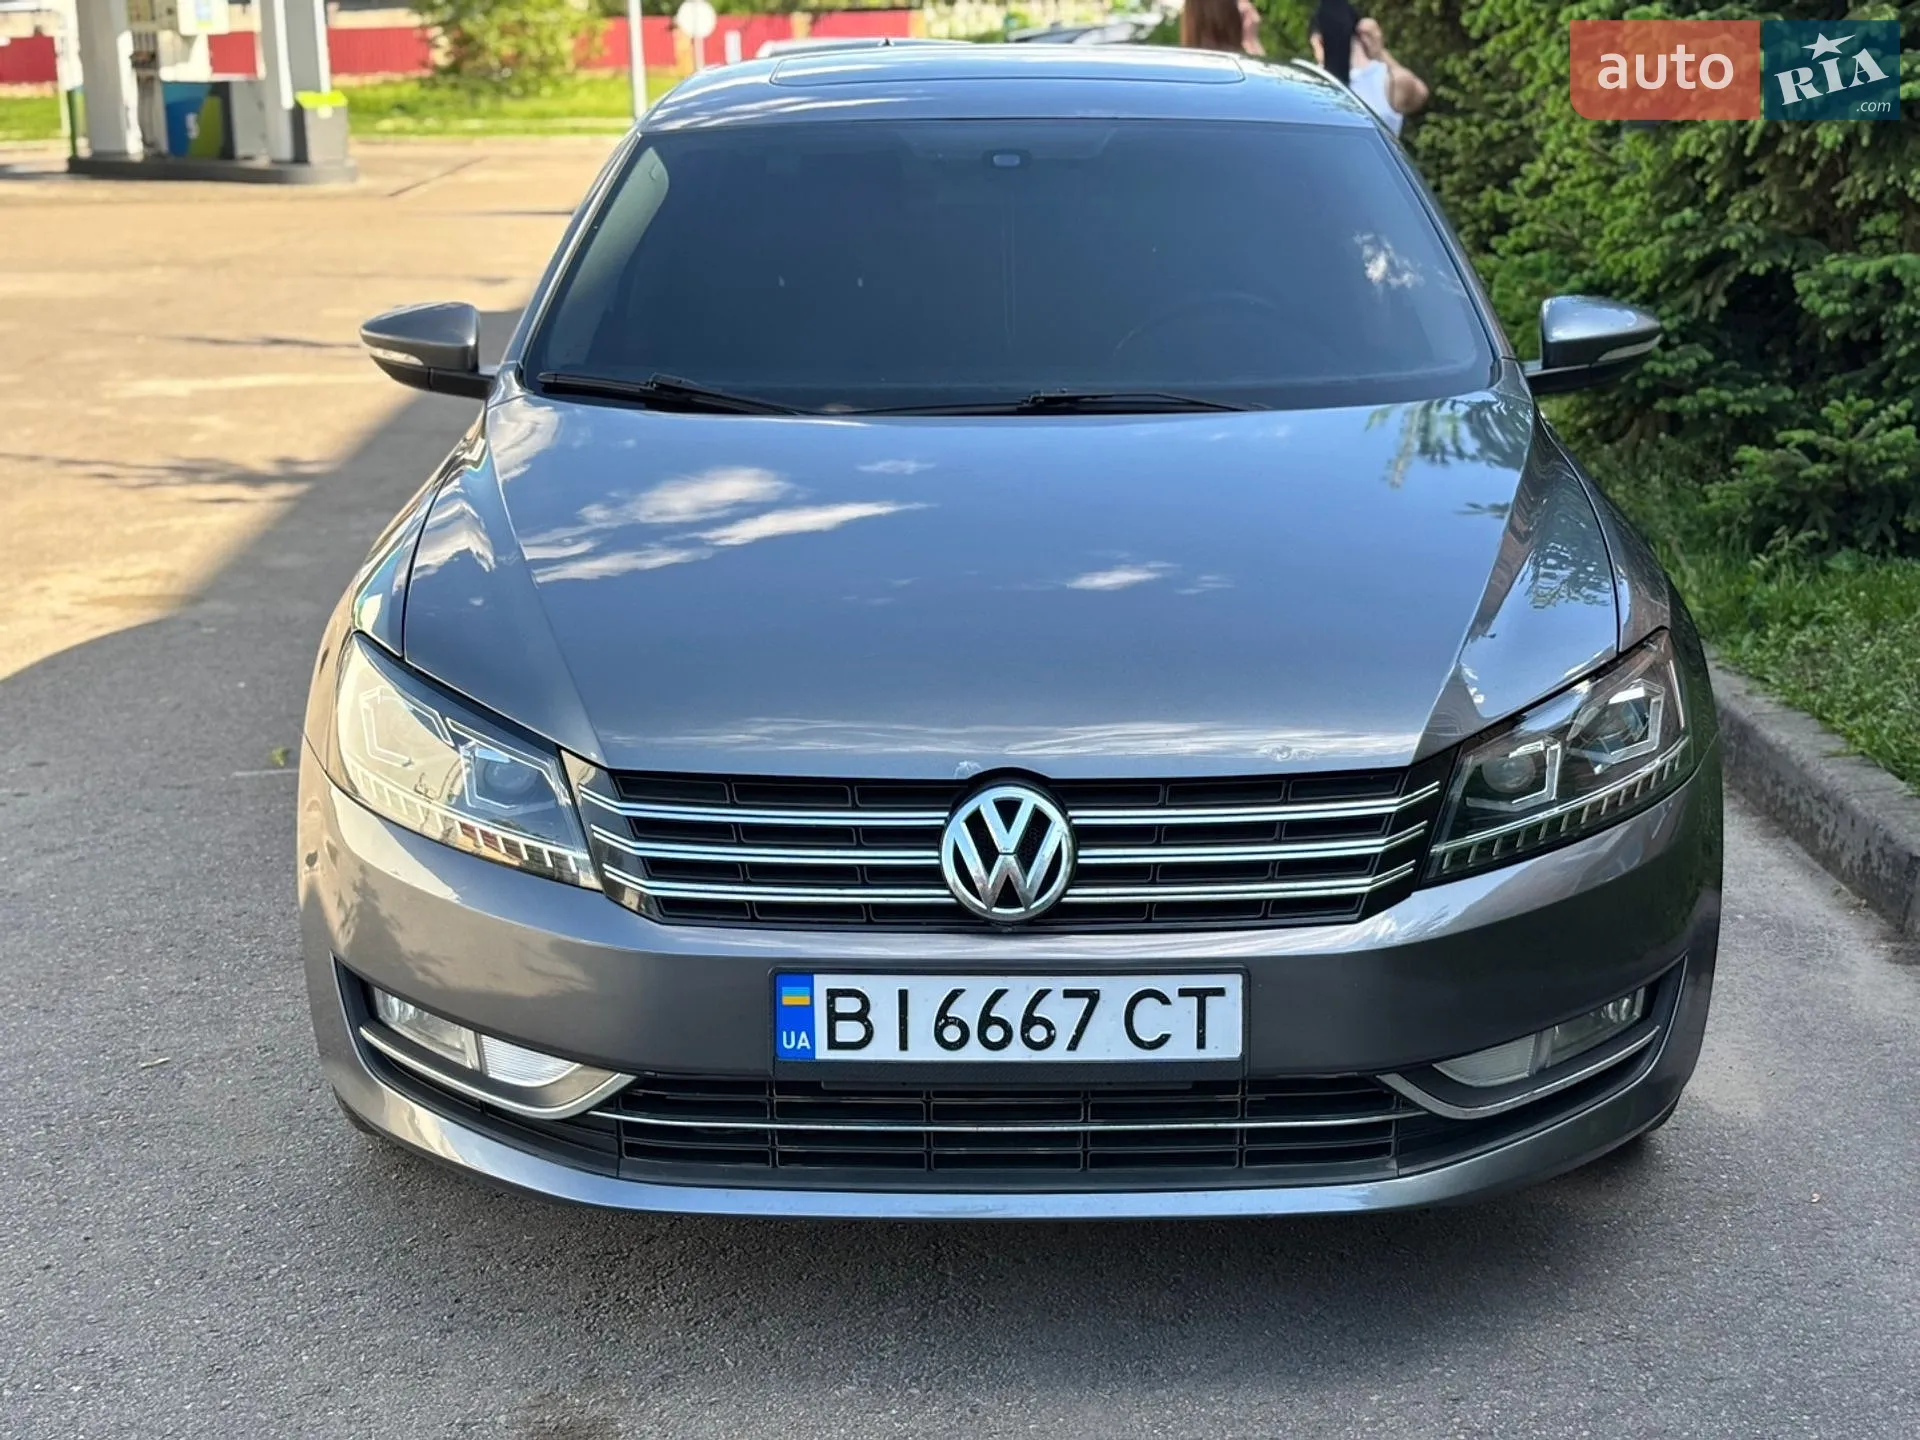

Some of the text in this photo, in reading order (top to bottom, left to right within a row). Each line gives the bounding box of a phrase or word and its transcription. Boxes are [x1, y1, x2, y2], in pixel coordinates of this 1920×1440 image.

[934, 987, 1101, 1052] 6667
[1123, 986, 1227, 1051] CT
[782, 1031, 812, 1050] UA
